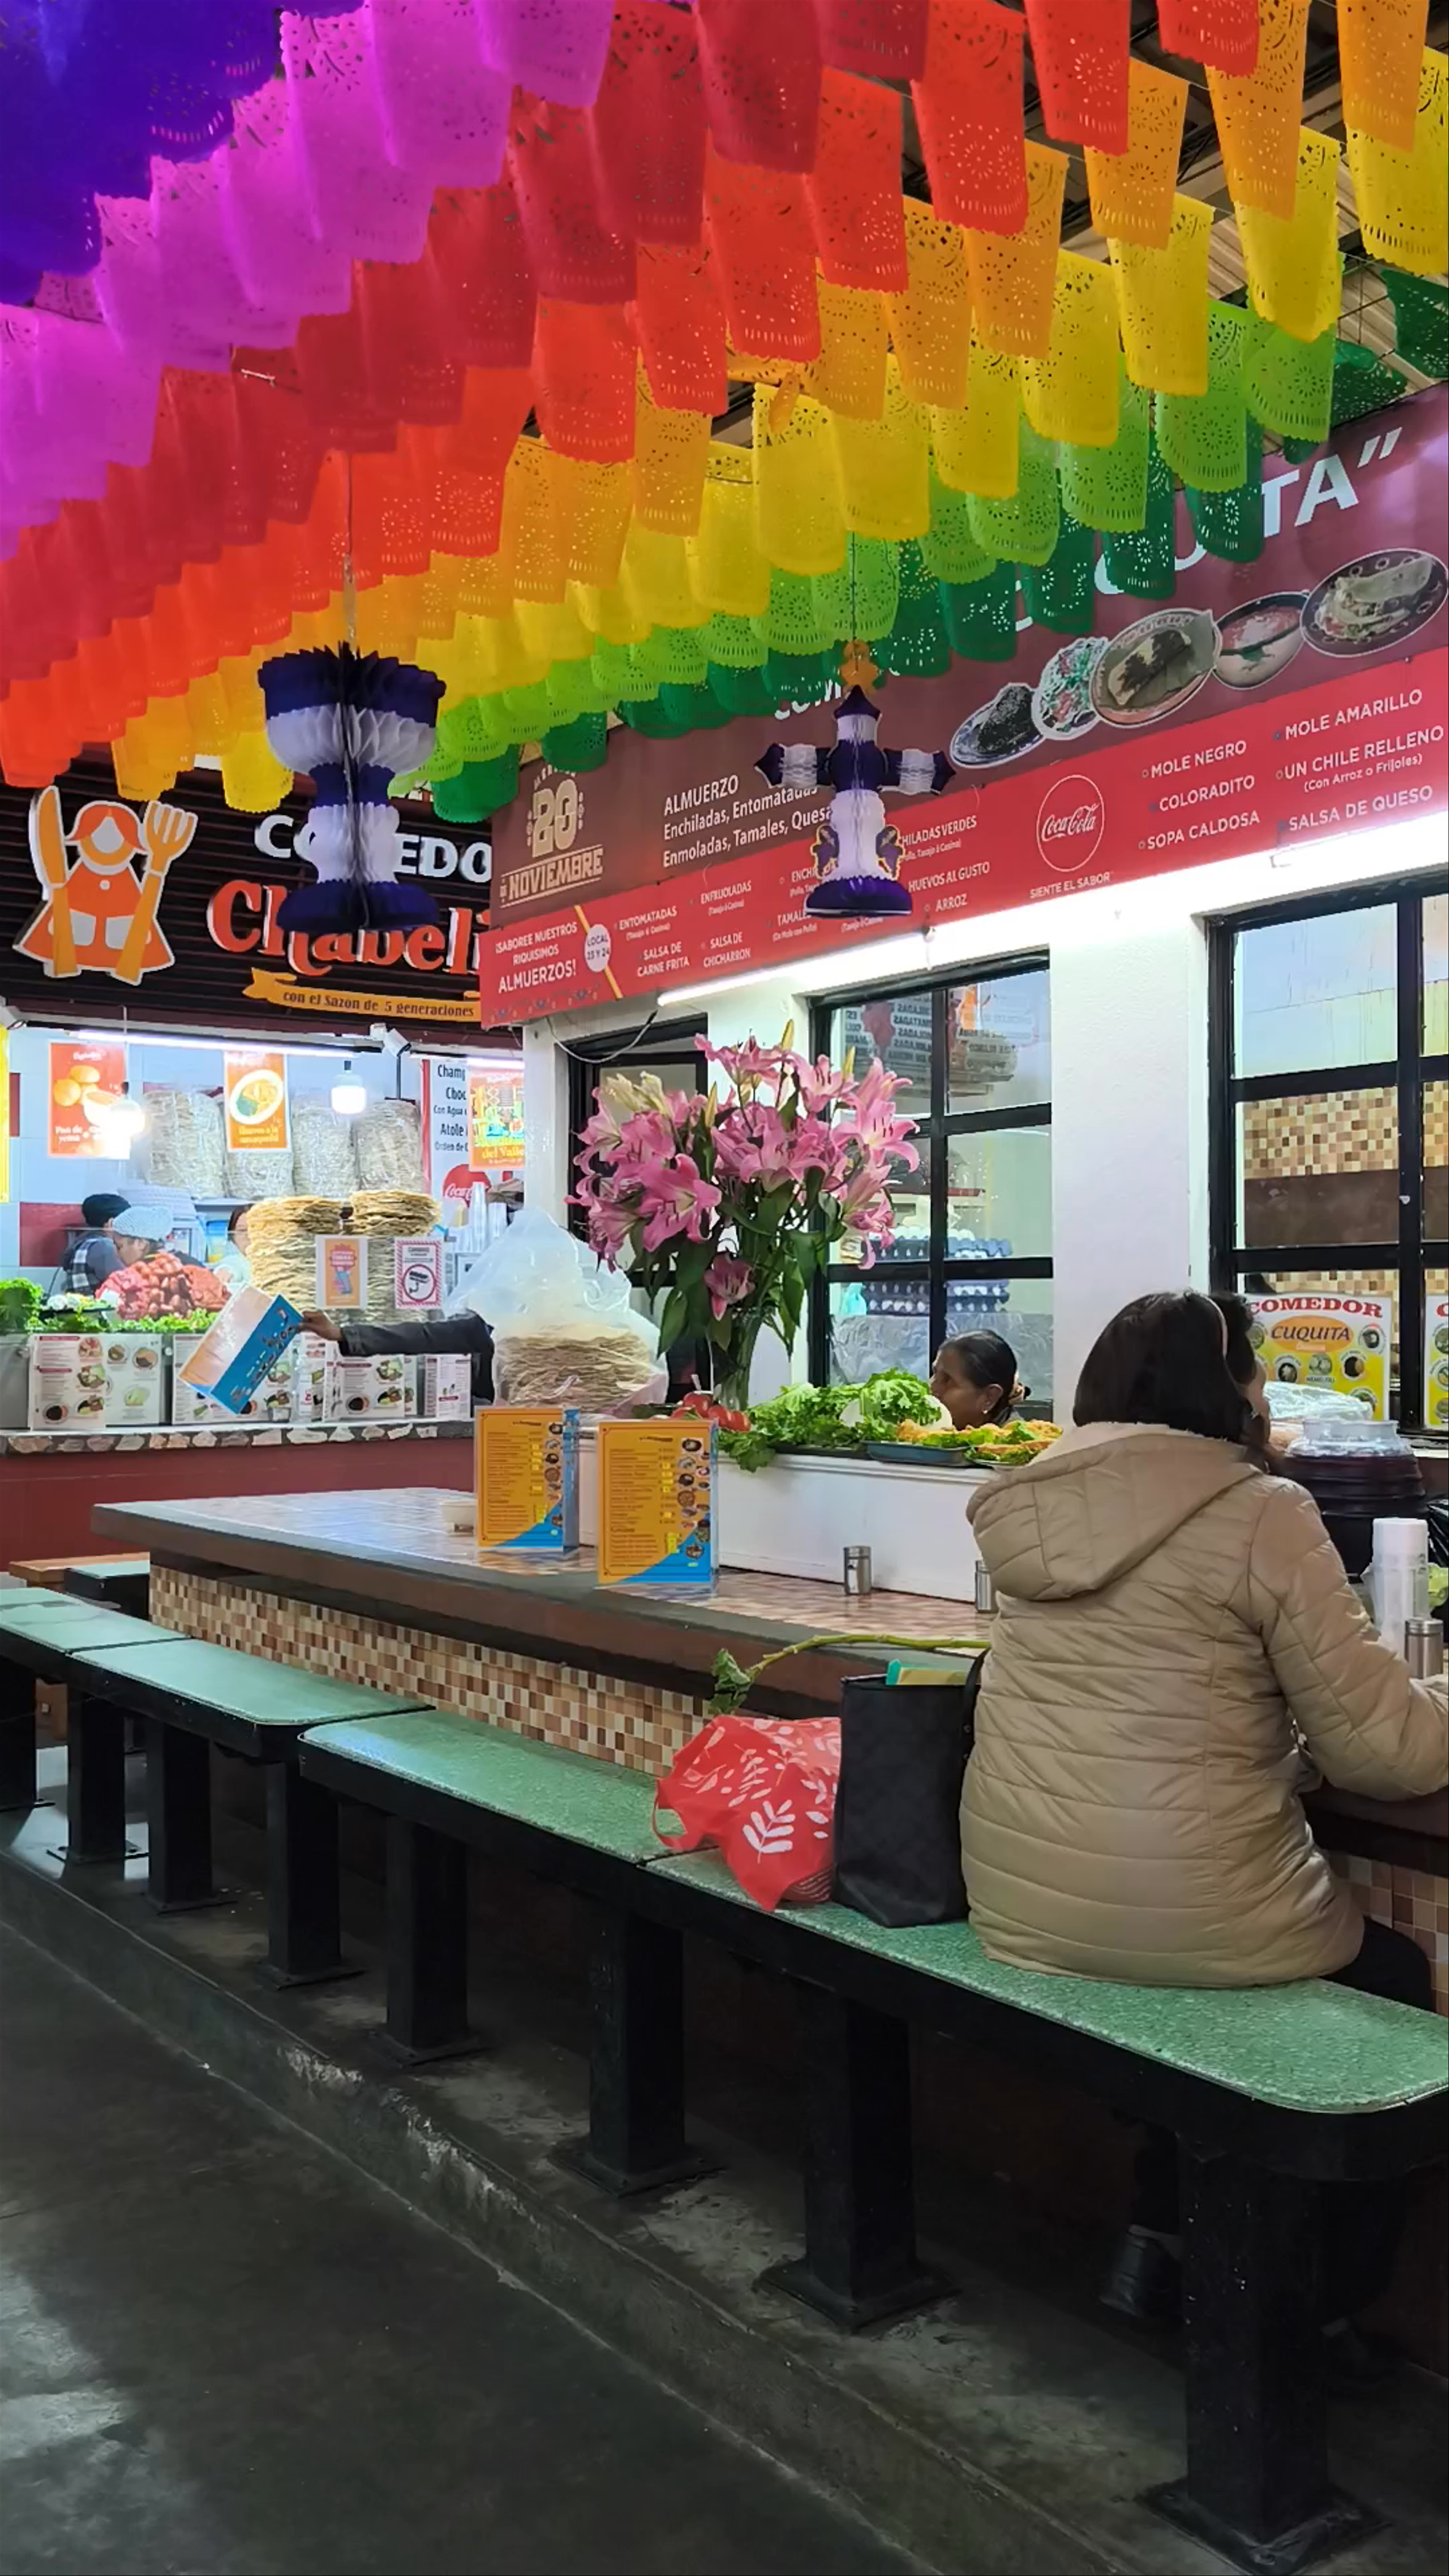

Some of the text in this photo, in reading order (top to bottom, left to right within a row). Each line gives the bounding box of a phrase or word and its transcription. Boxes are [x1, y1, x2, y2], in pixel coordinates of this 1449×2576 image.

[1286, 688, 1422, 739] MOLE AMARILLO
[1151, 741, 1246, 778] MOLE NEGRO
[1285, 725, 1443, 780] UN CHILE RELLENO
[1332, 769, 1362, 784] Arroz
[1376, 754, 1422, 774] Frijoles)
[664, 774, 738, 816] ALMUERZO
[1160, 775, 1255, 812] COLORADITO
[1289, 785, 1432, 831] SALSA DE QUESO
[664, 809, 730, 840] Enchiladas,
[902, 815, 977, 846] HILADAS VERDES
[1147, 810, 1260, 850] SOPA CALDOSA
[663, 837, 731, 867] Enmoladas,
[733, 819, 788, 847] Tamales,
[509, 848, 603, 900] NOVIEMBRE
[908, 862, 989, 892] HUEVOS AL GUSTO
[1030, 872, 1110, 898] SIENTE EL SABOR
[935, 894, 968, 912] ARROZ
[619, 906, 677, 930] ENTOMATADAS
[777, 910, 811, 926] TAMALE
[535, 922, 577, 943] NUESTROS
[588, 934, 608, 947] LOCAL
[710, 932, 743, 949] SALSA DE
[643, 942, 682, 960] SALSA DE
[498, 959, 576, 994] ALMUERZOS!
[637, 956, 690, 977] CARNE FRITA
[283, 992, 305, 1004] con
[309, 990, 321, 1005] el
[364, 997, 378, 1011] de
[385, 1001, 392, 1012] 5
[396, 1002, 474, 1016] generaciones
[434, 1105, 463, 1118] Con Agua
[440, 1124, 464, 1137] Atole
[455, 1143, 464, 1152] de
[1250, 1298, 1383, 1318] COMEDOR
[1271, 1326, 1350, 1342] CUQUITA
